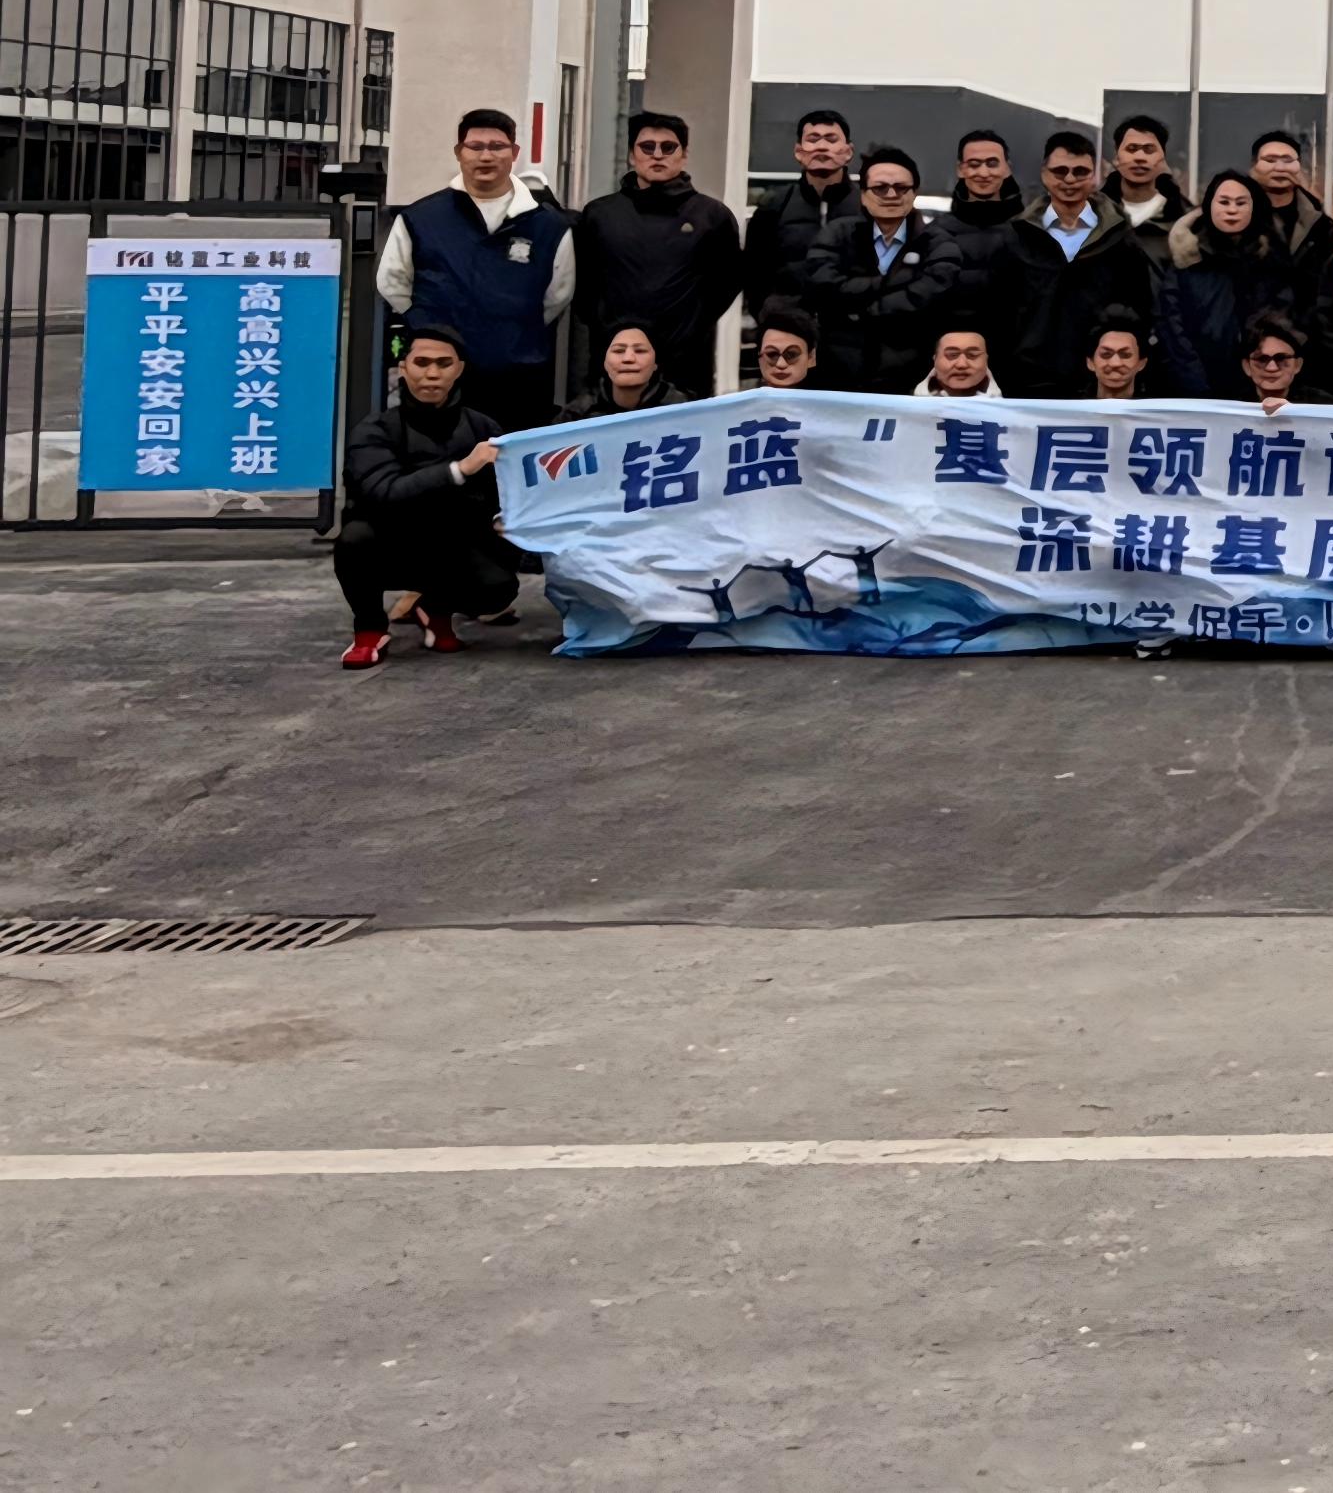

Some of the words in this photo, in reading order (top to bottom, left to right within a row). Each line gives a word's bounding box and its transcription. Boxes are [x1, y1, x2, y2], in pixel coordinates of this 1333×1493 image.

[135, 282, 188, 476] 平平安安回家
[230, 282, 284, 475] 高高兴兴上班
